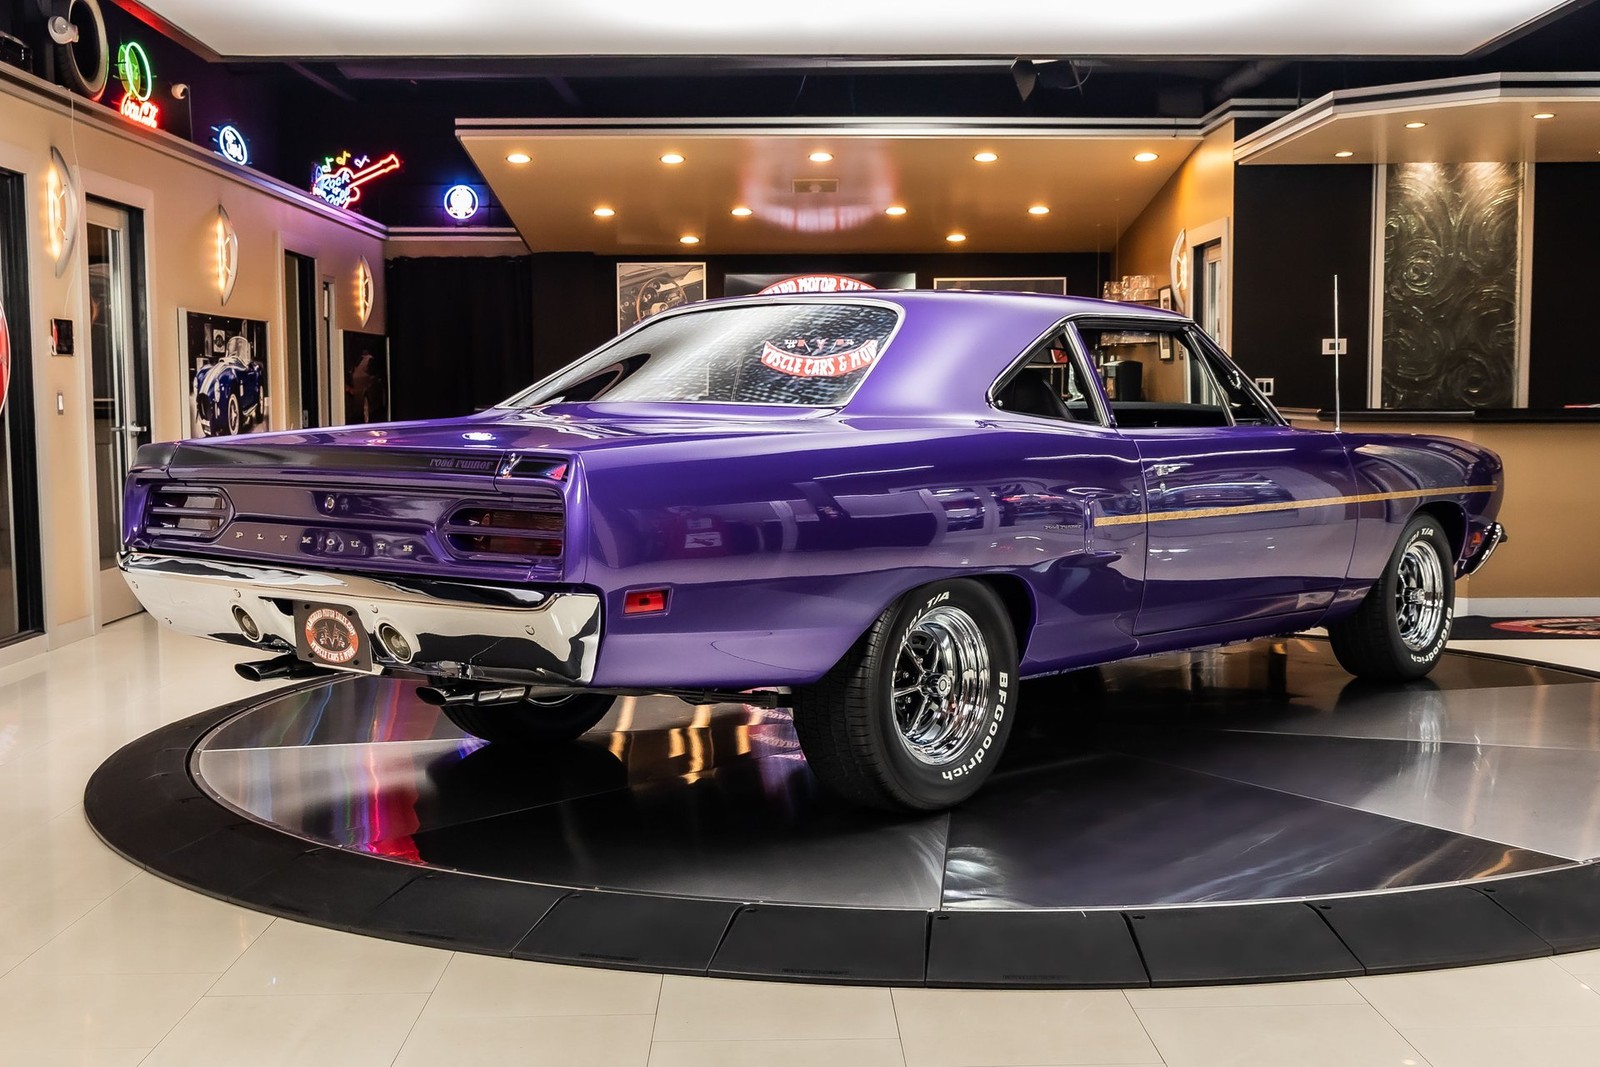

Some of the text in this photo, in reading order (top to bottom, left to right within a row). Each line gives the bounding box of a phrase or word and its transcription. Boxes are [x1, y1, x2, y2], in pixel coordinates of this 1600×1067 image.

[797, 277, 837, 292] MOTOR
[804, 358, 835, 376] CARS
[837, 355, 848, 372] &
[235, 531, 413, 552] PLYMOUTH
[1421, 527, 1434, 537] T/A
[926, 591, 950, 608] T/A
[1410, 607, 1453, 664] BFGoodrich
[942, 672, 1008, 781] BFGoodrich
